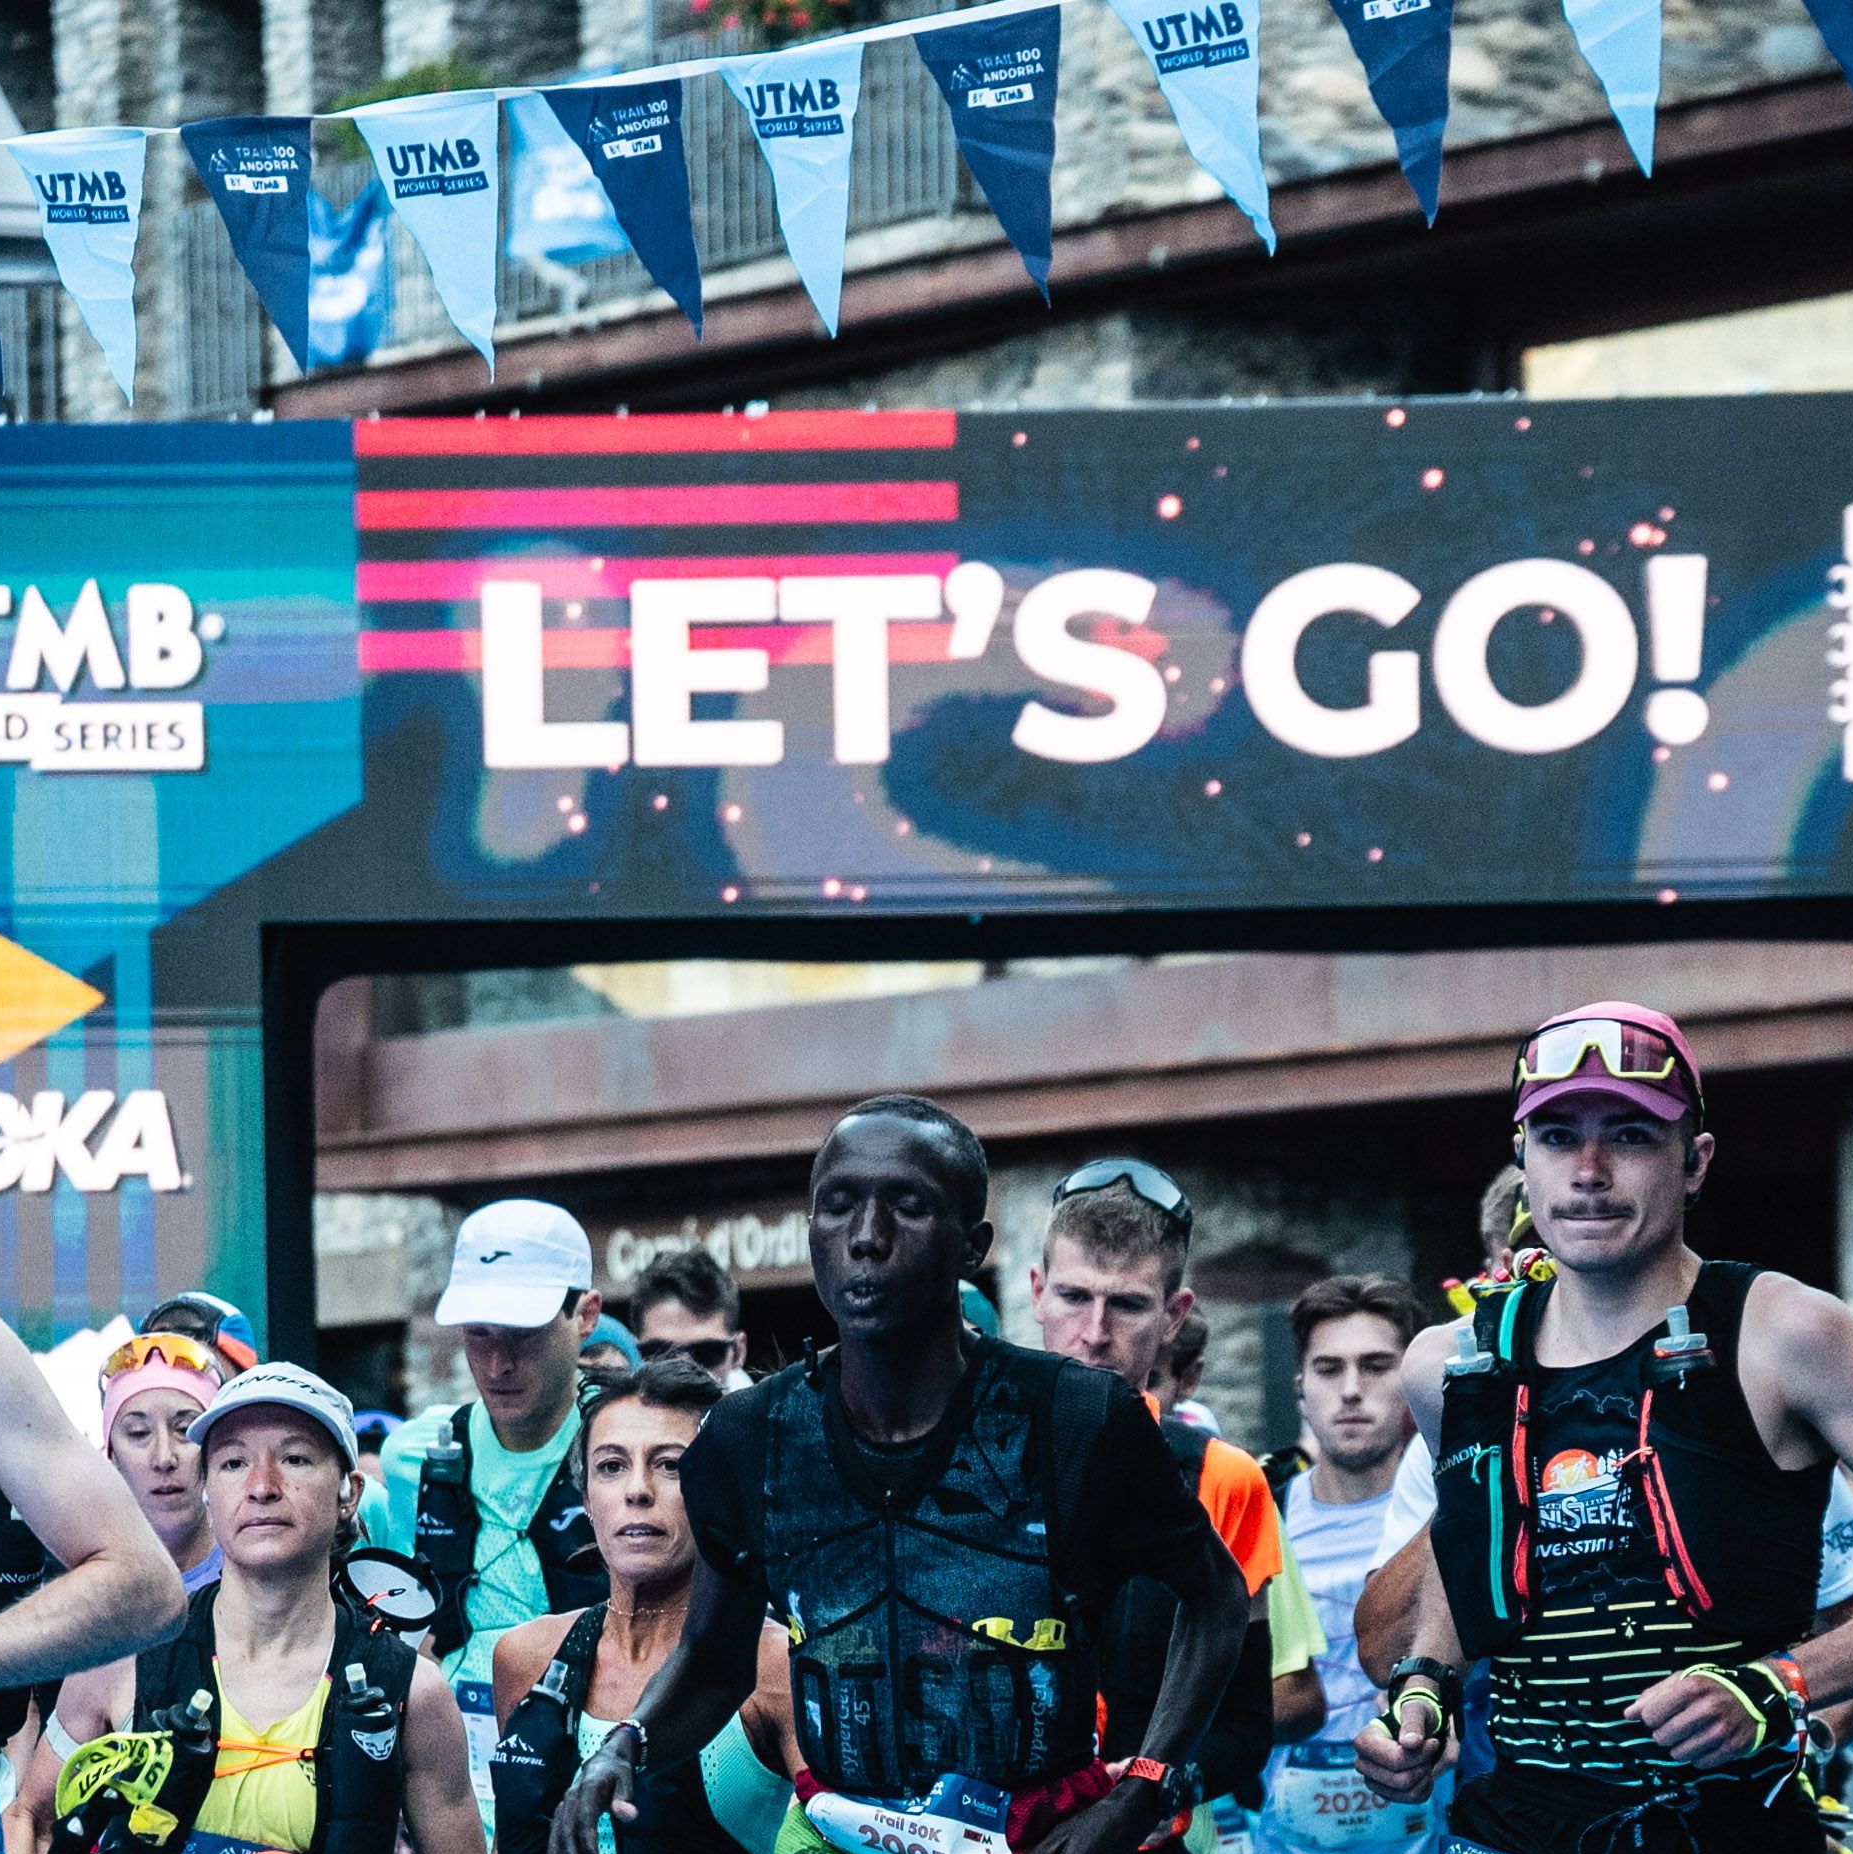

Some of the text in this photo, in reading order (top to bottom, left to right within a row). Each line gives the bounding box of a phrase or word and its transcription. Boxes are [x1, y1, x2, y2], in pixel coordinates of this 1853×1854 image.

[1143, 1, 1244, 52] UTMB
[1016, 47, 1041, 63] 100
[983, 63, 1044, 84] ANDORRA
[648, 100, 668, 115] 100
[746, 78, 840, 117] UTMB
[616, 115, 670, 135] ANDORRA
[239, 158, 298, 173] ANDORRA
[272, 146, 295, 158] 100
[387, 138, 480, 177] UTMB
[35, 170, 126, 203] UTMB
[481, 554, 1709, 768] LET'S GO!
[55, 722, 185, 752] SERIES
[874, 1809, 945, 1843] Trail 50K
